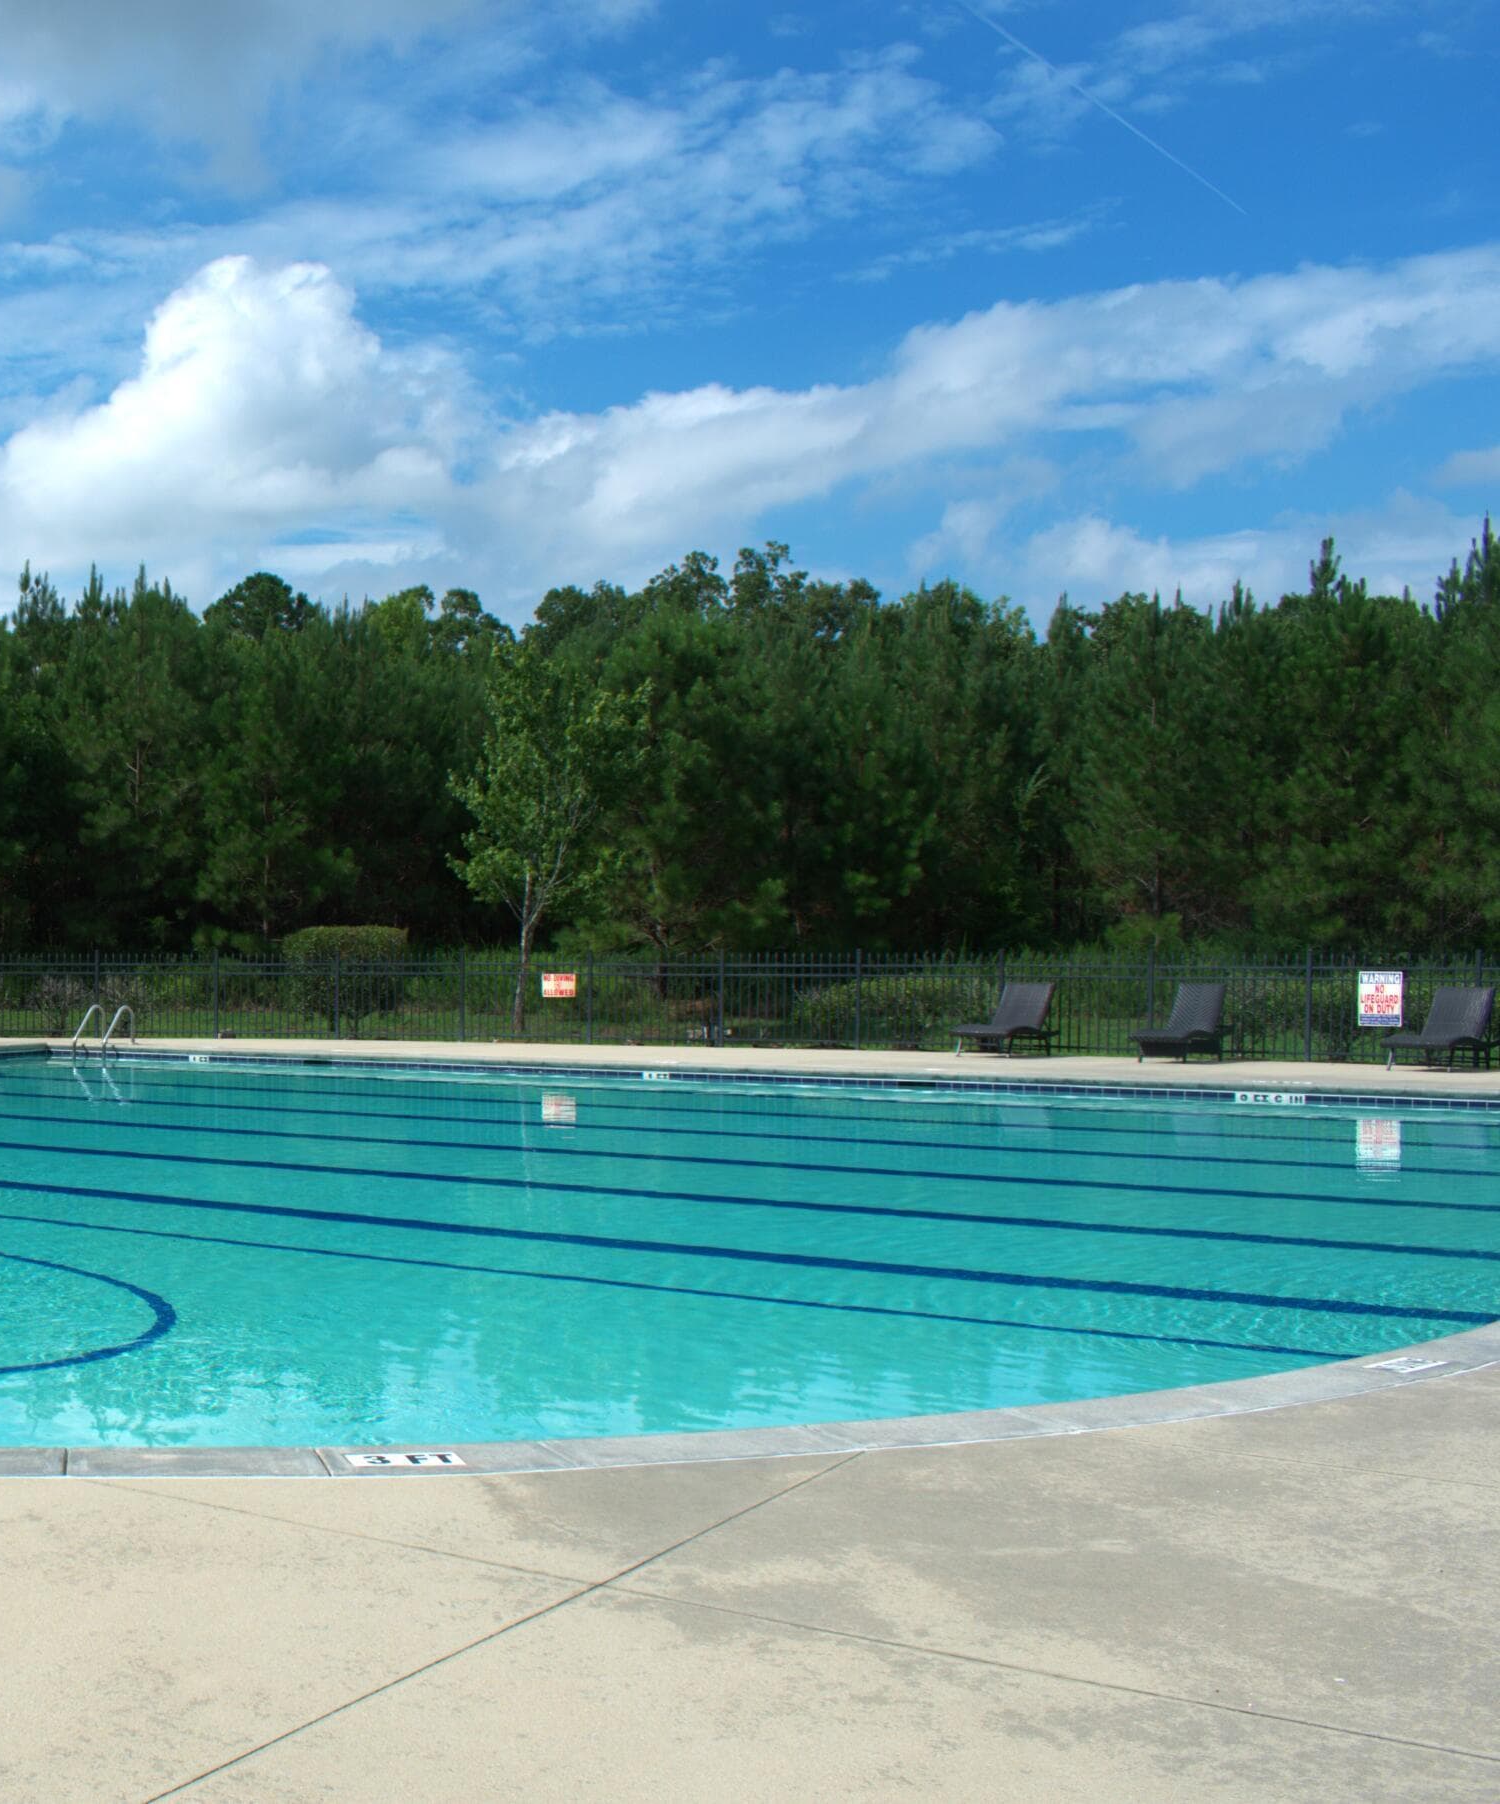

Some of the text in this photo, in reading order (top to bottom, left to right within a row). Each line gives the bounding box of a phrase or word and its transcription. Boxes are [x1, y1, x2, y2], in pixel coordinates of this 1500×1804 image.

[1361, 973, 1400, 984] WARNING
[1375, 984, 1385, 993] NO
[1361, 994, 1399, 1004] LIFEGUARD
[1364, 1004, 1395, 1014] ON DUTY
[362, 1453, 454, 1465] 3 FT
